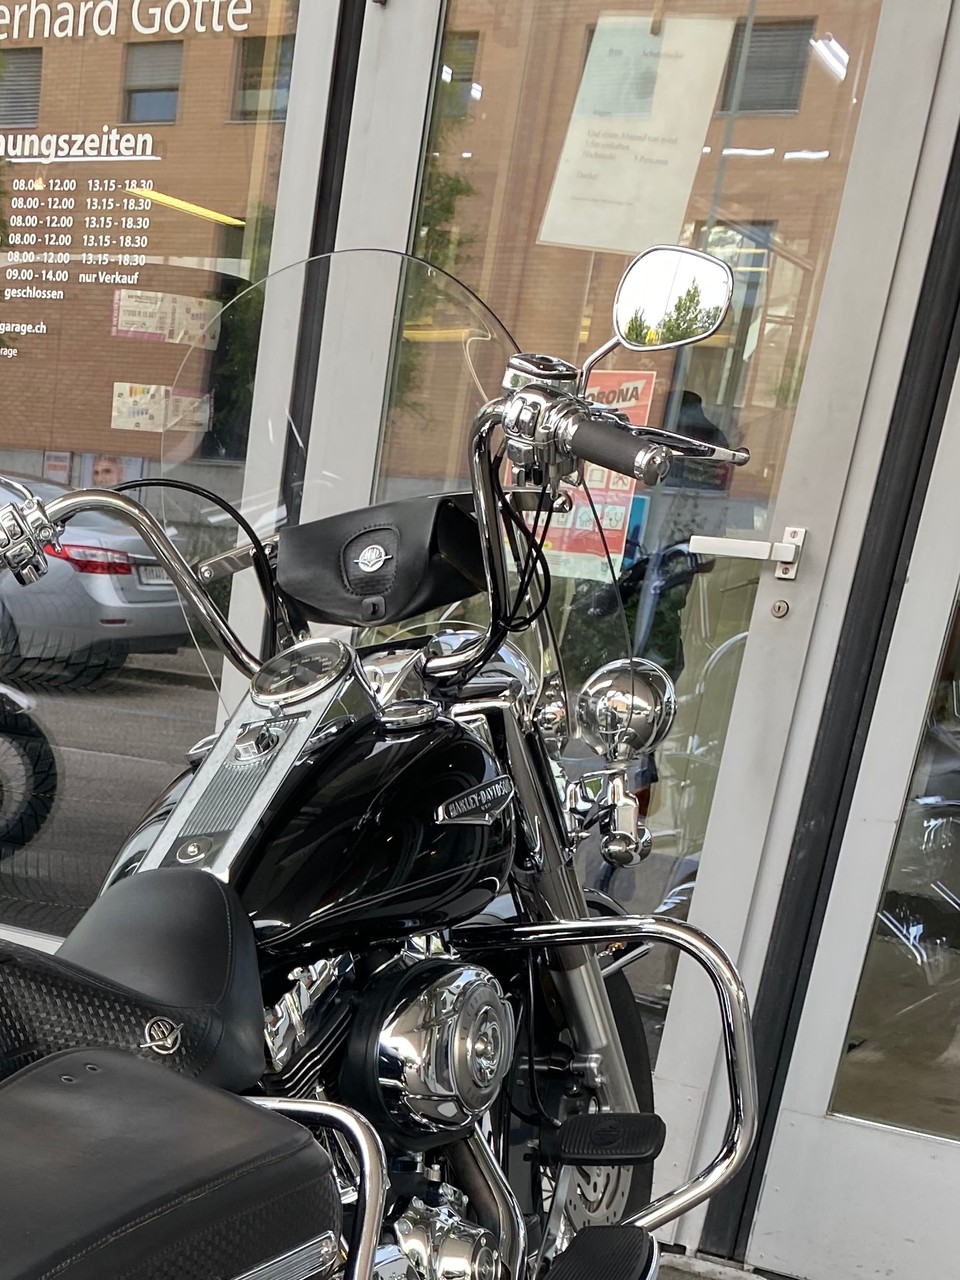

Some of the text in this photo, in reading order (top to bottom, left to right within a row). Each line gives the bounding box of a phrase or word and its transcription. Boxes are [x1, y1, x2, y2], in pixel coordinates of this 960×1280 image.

[12, 179, 43, 191] 08.0
[48, 179, 76, 191] 12.00
[87, 179, 116, 191] 13.15
[11, 197, 39, 209] 08.00
[47, 197, 75, 210] 12.00
[86, 197, 114, 210] 13.15
[122, 198, 152, 211] 18.30
[10, 215, 38, 227] 08.00
[45, 216, 73, 228] 12.00
[84, 216, 113, 228] 13.15
[121, 217, 150, 230] 18.30
[8, 233, 36, 246] 08.00
[44, 234, 72, 246] 12.00
[82, 234, 111, 247] 13.15
[119, 235, 148, 248] 18.30
[7, 251, 35, 263] 08.00
[42, 251, 70, 264] 12.00
[81, 253, 109, 265] 13.15
[117, 253, 146, 266] 18.30
[5, 268, 34, 281] 09.00
[41, 269, 69, 282] 14.00
[79, 273, 97, 284] nur
[98, 271, 139, 285] Verkauf
[4, 286, 64, 300] geschlossen
[587, 386, 639, 405] ORONA
